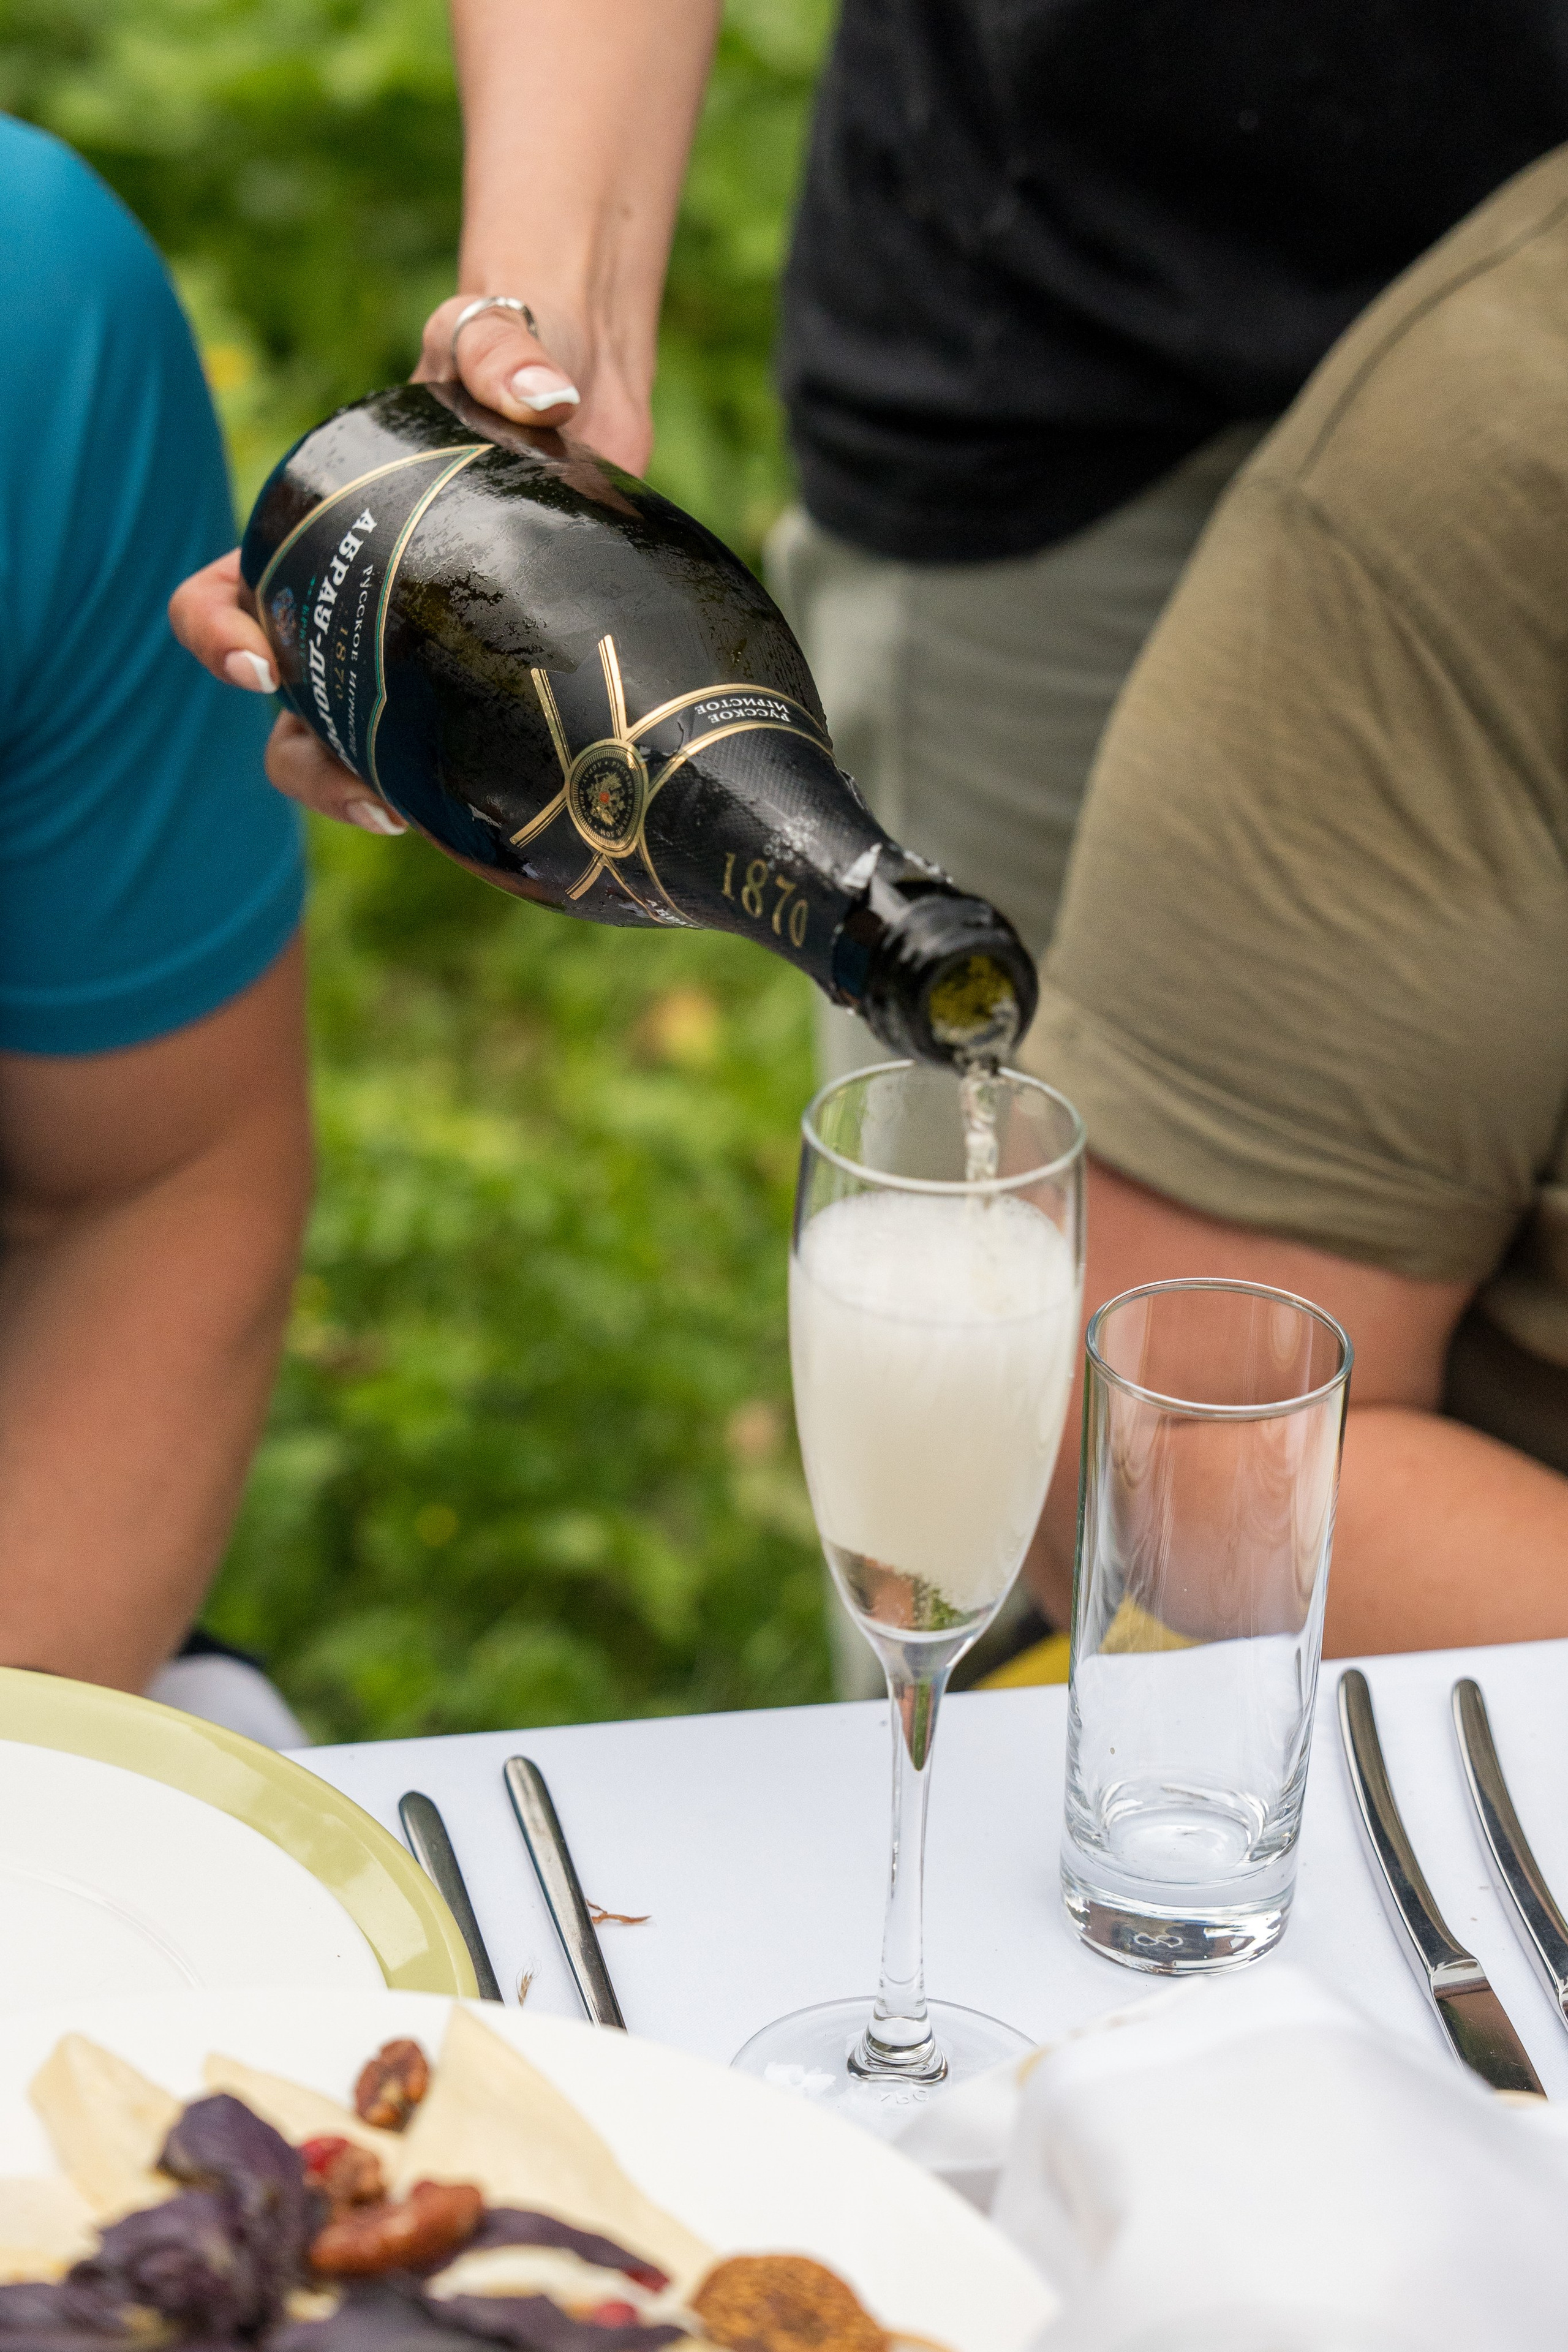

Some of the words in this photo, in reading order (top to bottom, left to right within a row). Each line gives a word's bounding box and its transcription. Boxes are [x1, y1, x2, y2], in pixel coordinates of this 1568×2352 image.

[350, 564, 374, 662] РУССКОЕ
[334, 627, 349, 699] 1870
[694, 698, 790, 715] ИГРИСТОЕ
[707, 708, 791, 724] РУССКОЕ
[721, 852, 809, 948] 1870
